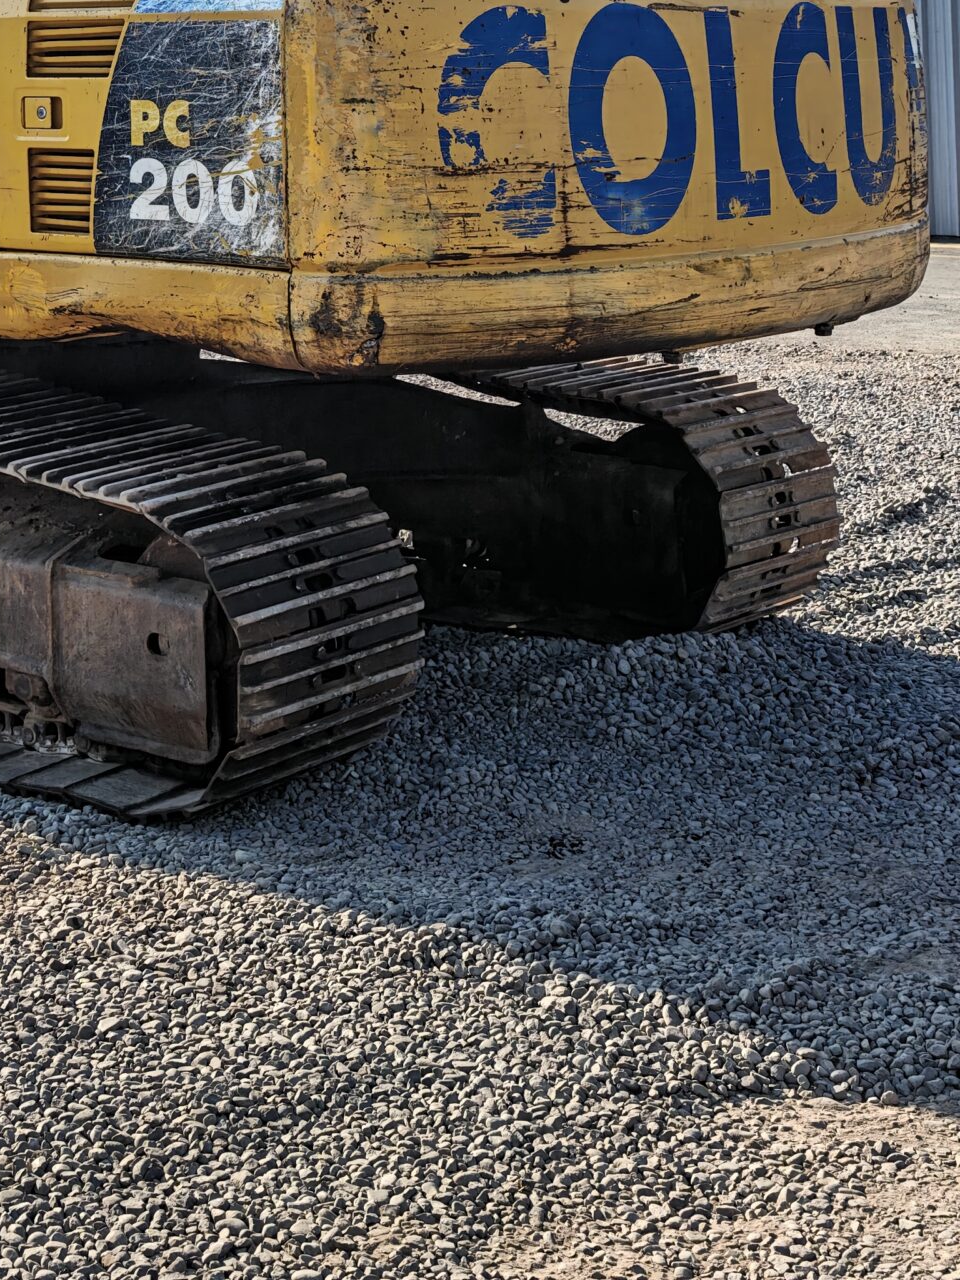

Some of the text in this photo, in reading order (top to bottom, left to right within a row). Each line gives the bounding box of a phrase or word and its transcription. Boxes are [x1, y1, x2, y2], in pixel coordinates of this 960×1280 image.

[129, 99, 191, 148] PC
[437, 1, 927, 239] COLCU
[129, 157, 260, 226] 200
